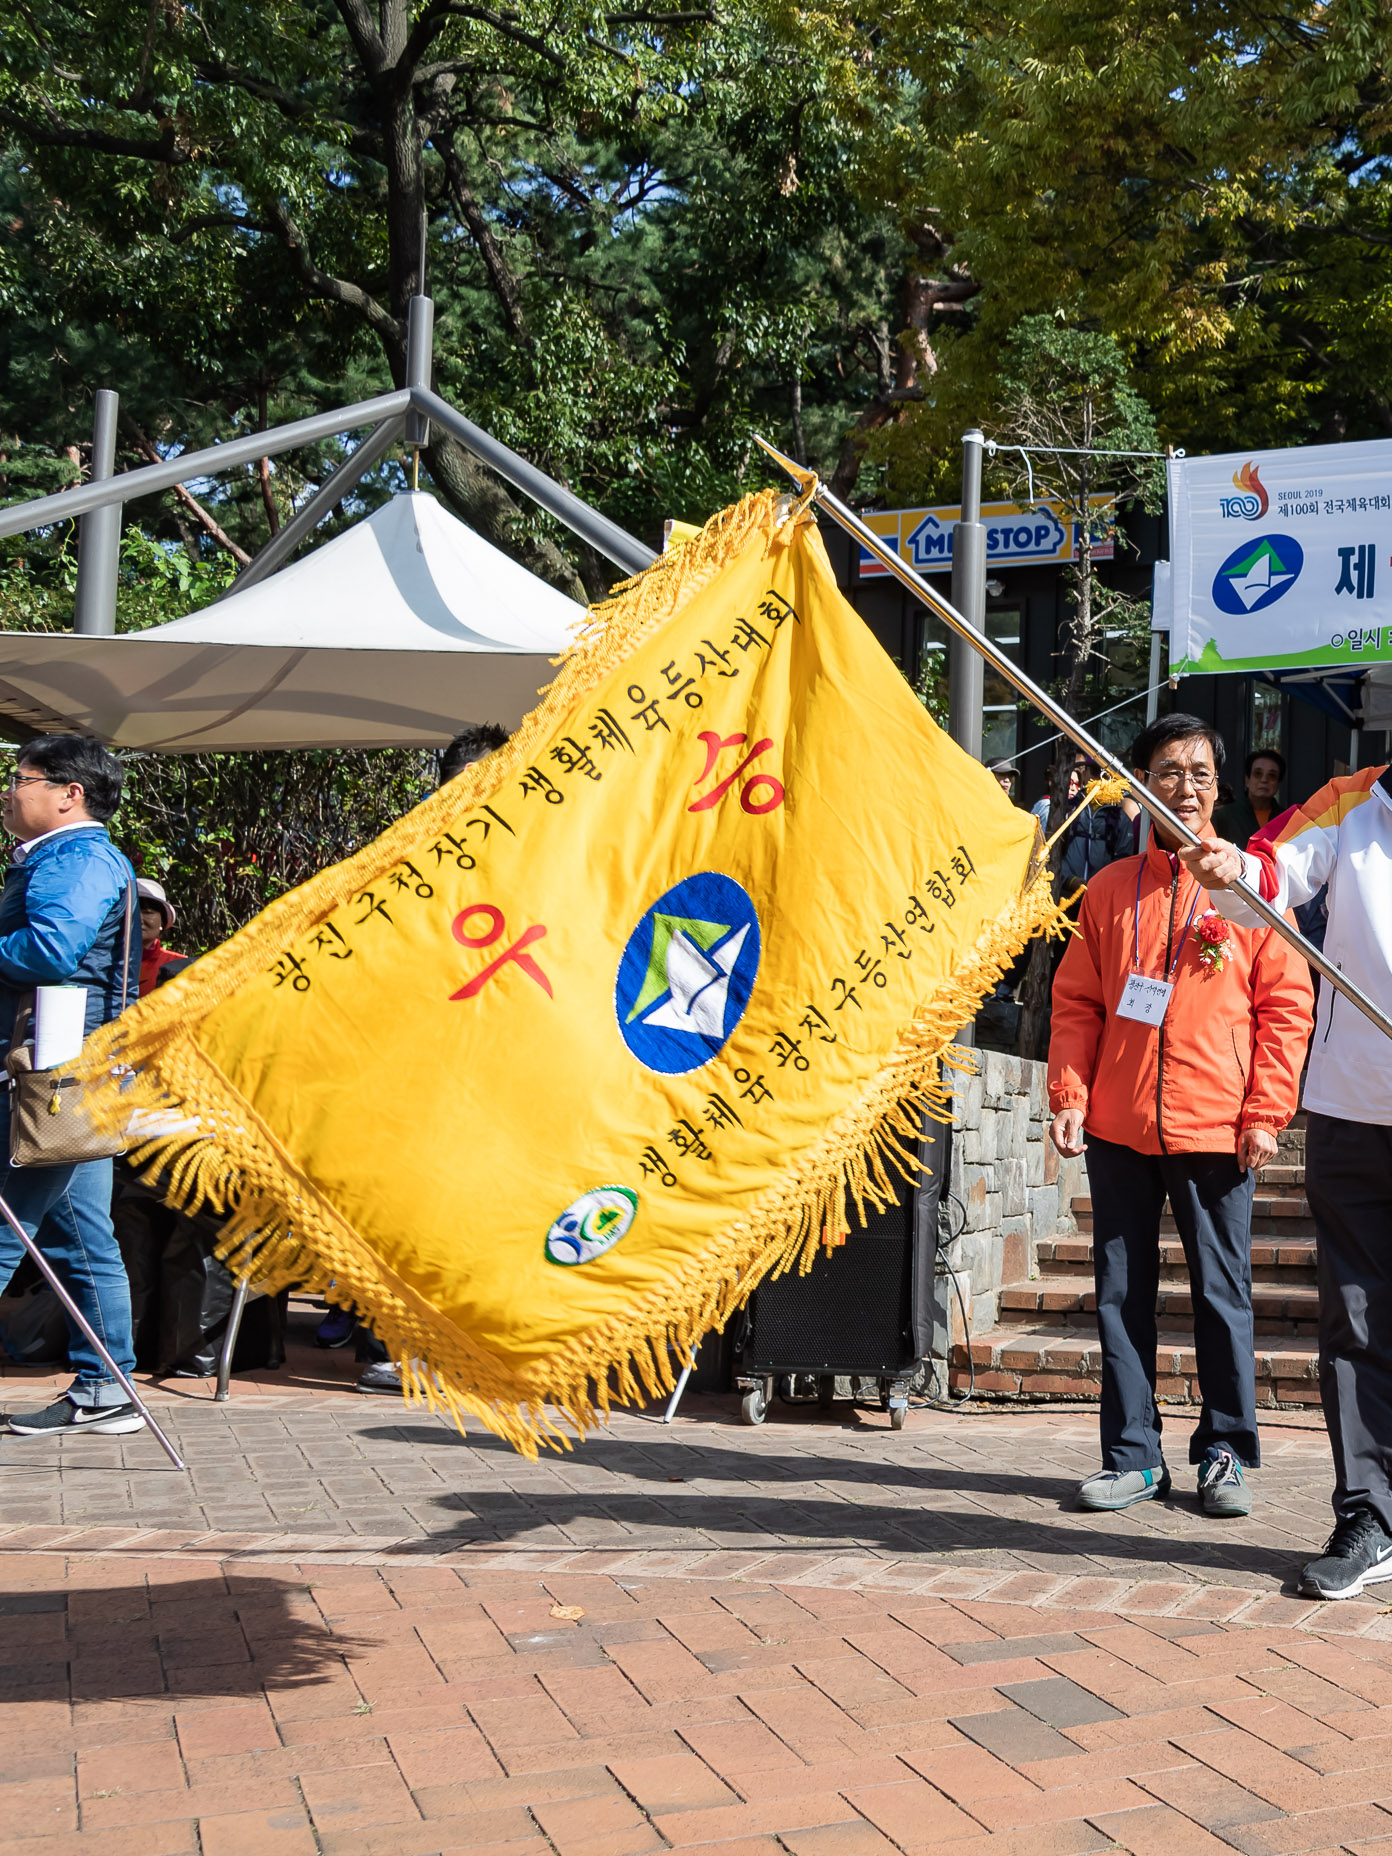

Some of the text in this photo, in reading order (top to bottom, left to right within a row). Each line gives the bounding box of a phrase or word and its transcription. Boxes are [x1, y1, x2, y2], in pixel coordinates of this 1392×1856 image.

[1278, 489, 1324, 501] SEOUL 2019
[1278, 494, 1392, 518] 제100회 전국체육대회
[924, 524, 1051, 556] MISTOP
[1334, 542, 1376, 600] 제
